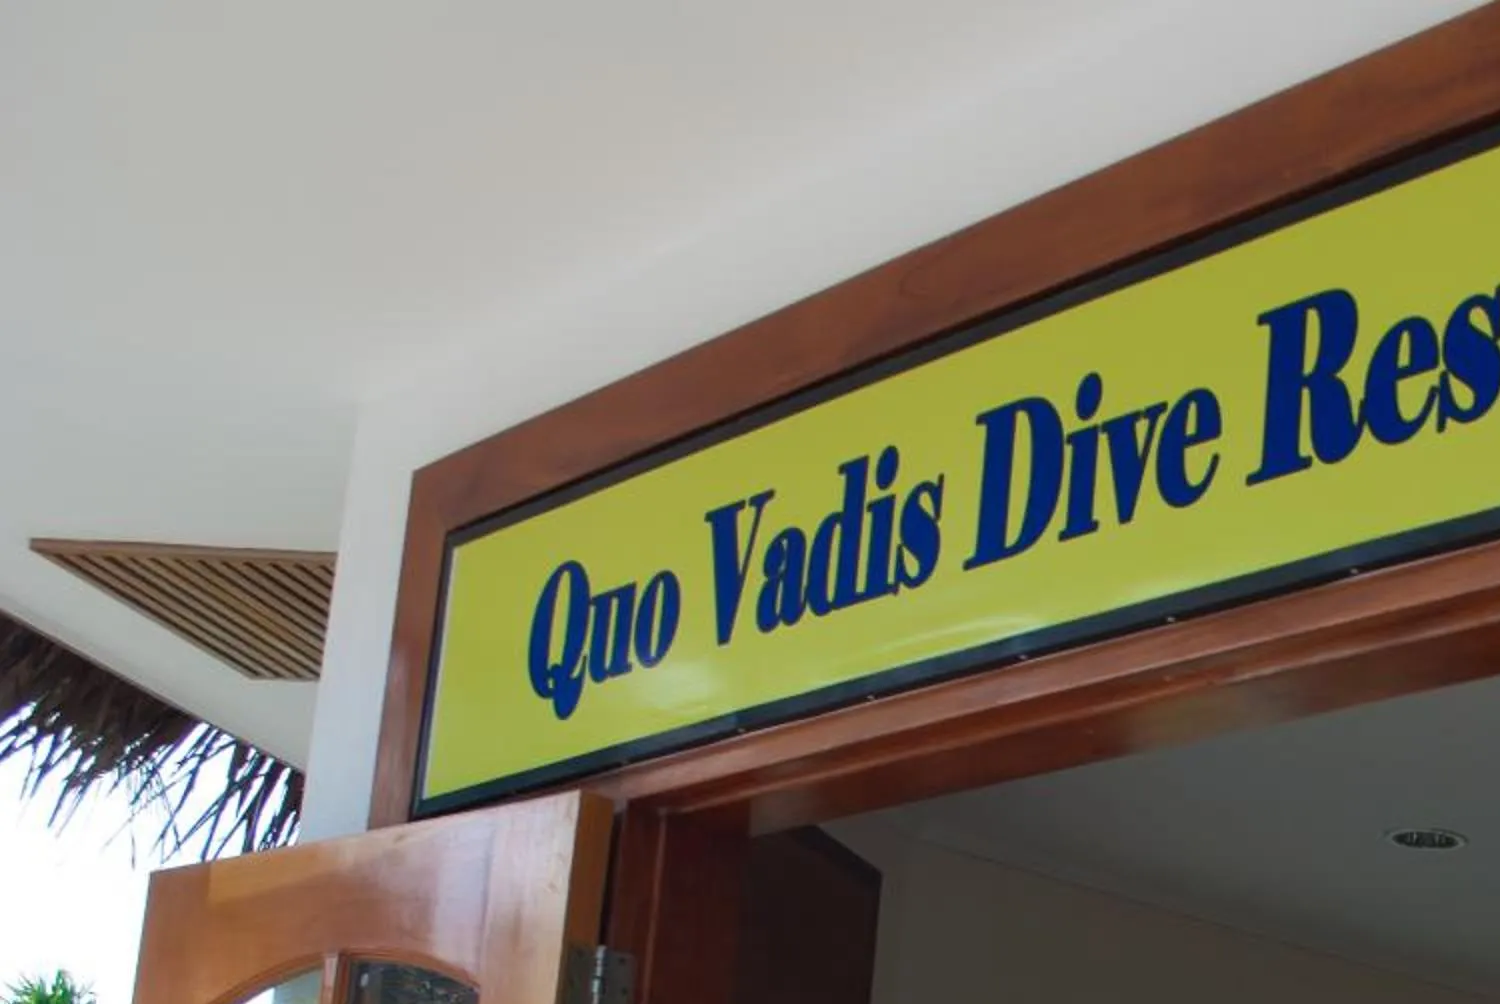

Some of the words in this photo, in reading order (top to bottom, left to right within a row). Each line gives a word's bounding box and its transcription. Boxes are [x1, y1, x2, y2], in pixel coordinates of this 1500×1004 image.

[528, 560, 680, 720] Quo
[704, 445, 944, 646] Vadis
[963, 372, 1221, 571] Dive
